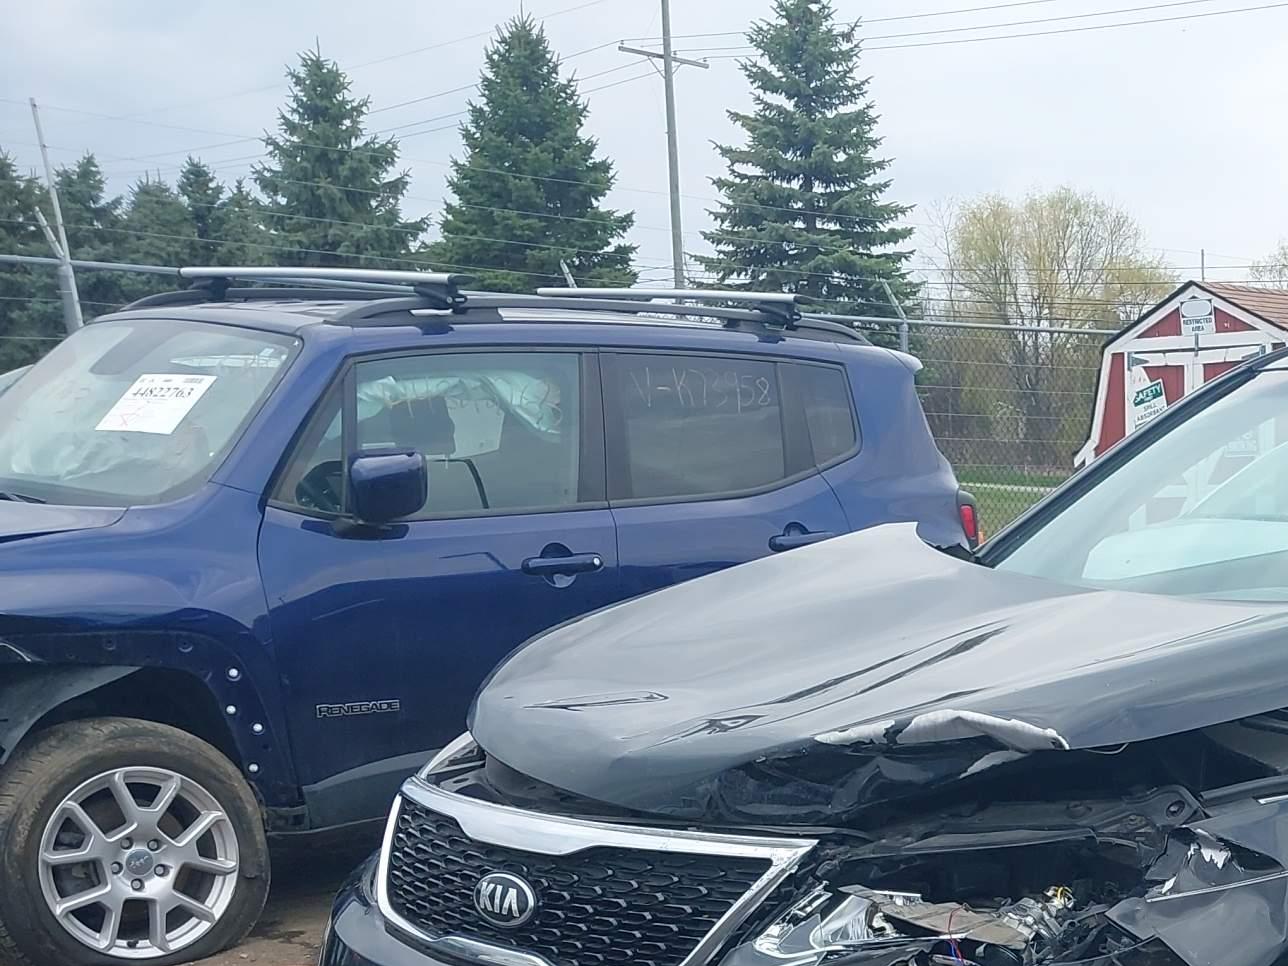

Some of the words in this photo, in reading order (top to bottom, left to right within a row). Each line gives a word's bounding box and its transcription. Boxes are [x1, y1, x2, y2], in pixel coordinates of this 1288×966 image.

[132, 386, 194, 398] 44822763
[316, 699, 401, 719] RENEGADE
[480, 881, 520, 918] KIA
